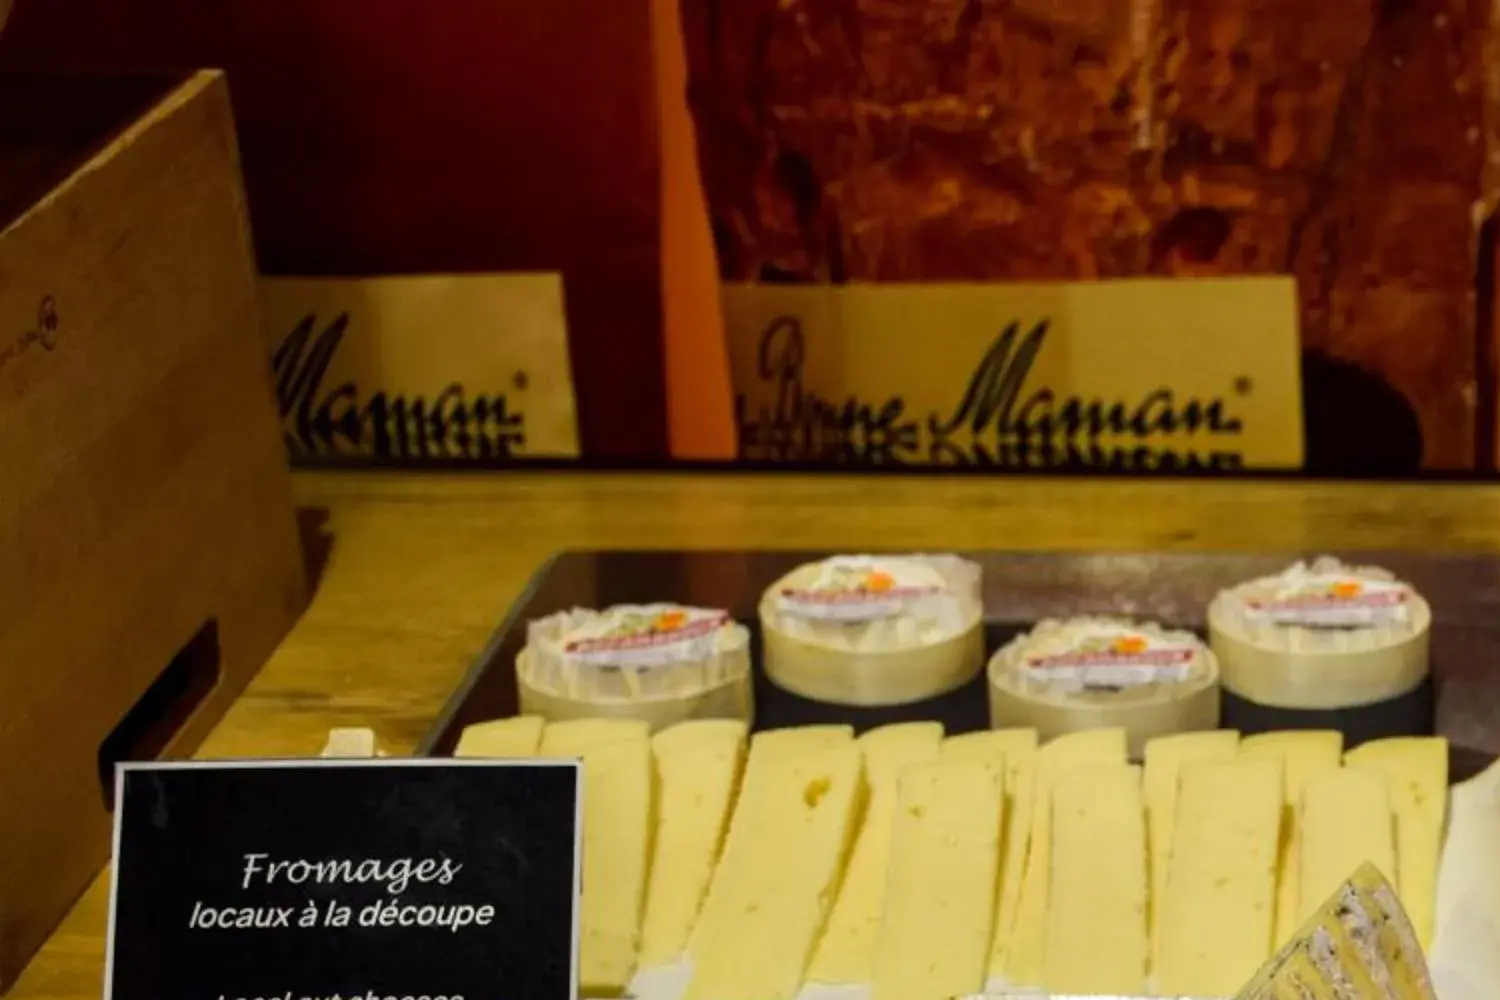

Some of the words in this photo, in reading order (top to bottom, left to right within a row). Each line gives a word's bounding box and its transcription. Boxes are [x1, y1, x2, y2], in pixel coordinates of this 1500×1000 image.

[242, 853, 463, 895] Fromages
[188, 900, 295, 929] locaux
[298, 899, 319, 927] à
[323, 899, 352, 927] la
[358, 897, 496, 933] découpe
